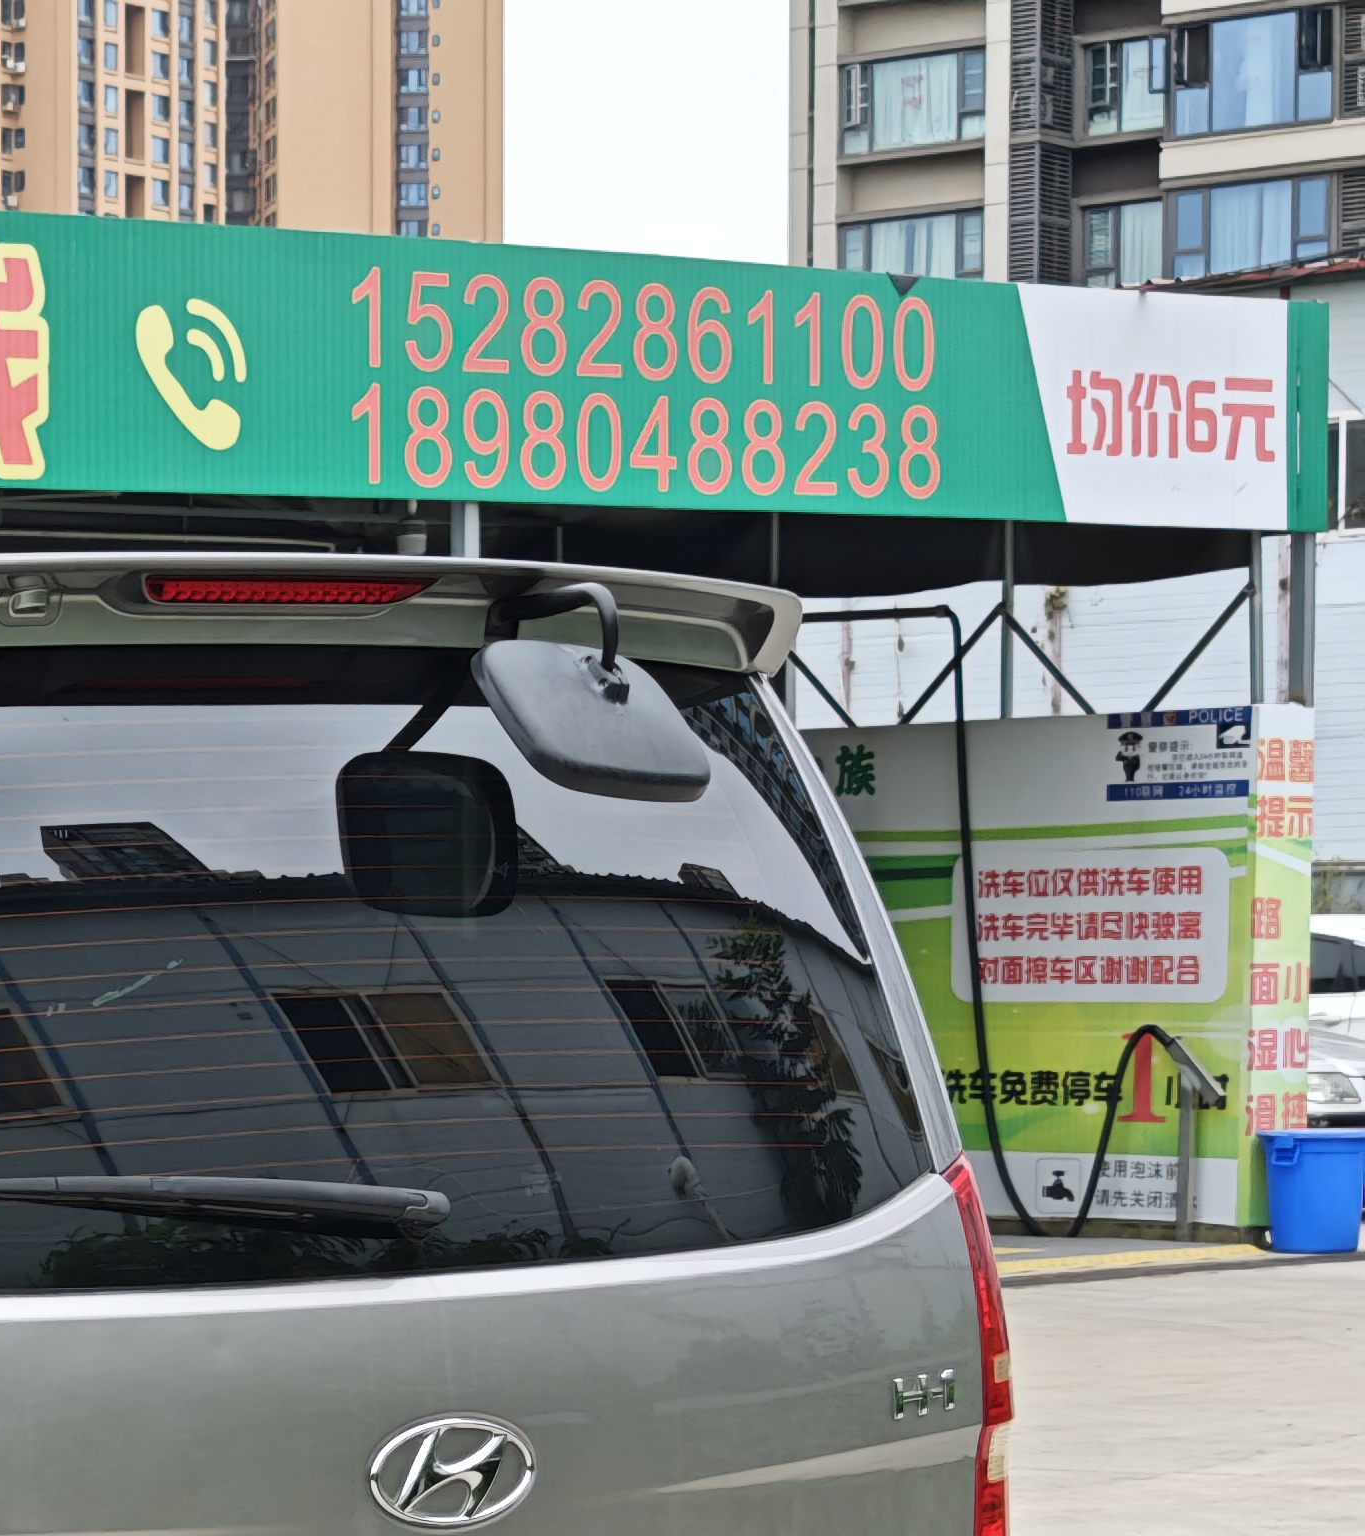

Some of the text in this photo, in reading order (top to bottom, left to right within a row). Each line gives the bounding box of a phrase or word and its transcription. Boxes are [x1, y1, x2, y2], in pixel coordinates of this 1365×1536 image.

[350, 266, 937, 393] 15282861100
[350, 382, 942, 501] 18980488238
[1066, 369, 1276, 463] 均价6元
[1188, 706, 1245, 724] POLICE
[814, 744, 876, 797] 族
[977, 865, 1202, 898] 洗车位仅供洗车使用
[976, 911, 1202, 941] 洗车完毕请尽快驶离
